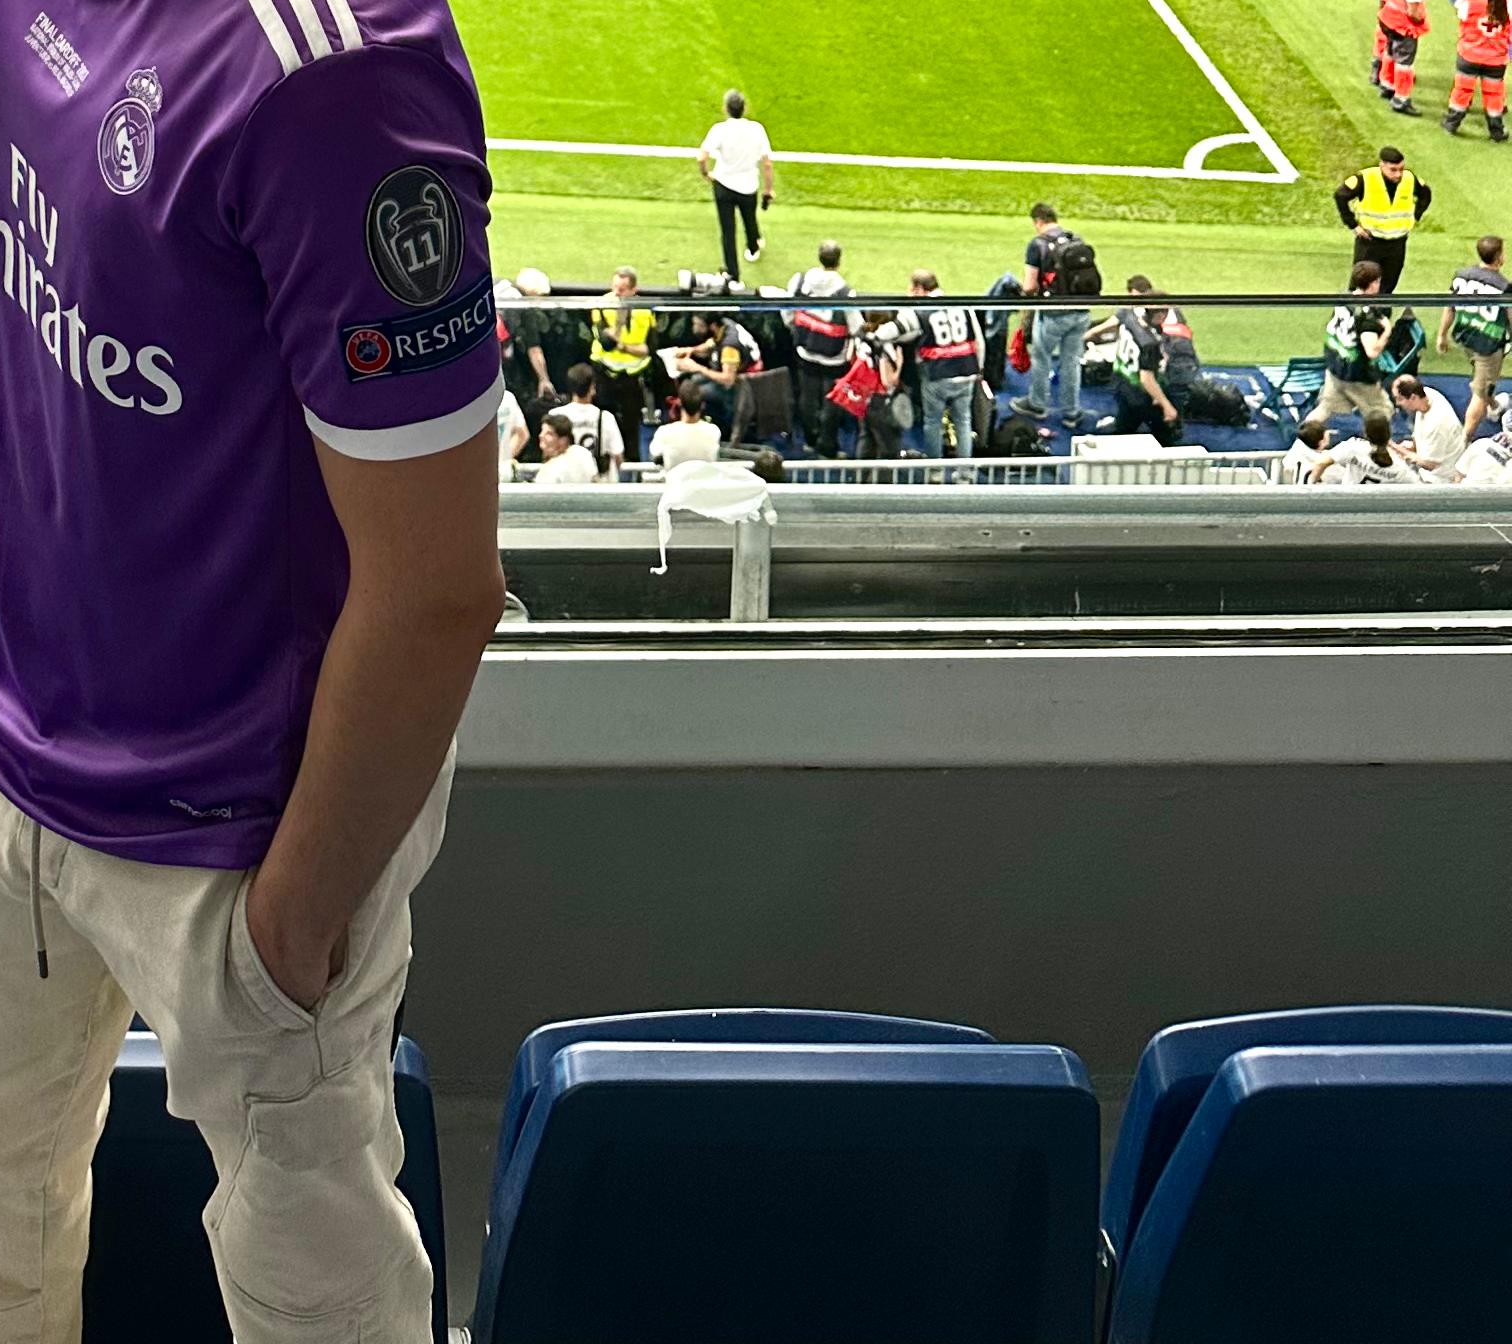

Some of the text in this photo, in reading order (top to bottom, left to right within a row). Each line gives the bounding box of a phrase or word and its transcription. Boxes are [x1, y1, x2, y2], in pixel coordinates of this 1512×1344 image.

[10, 142, 58, 267] Fly
[403, 230, 441, 273] 11
[395, 289, 492, 359] RESPECT
[929, 310, 967, 346] 68
